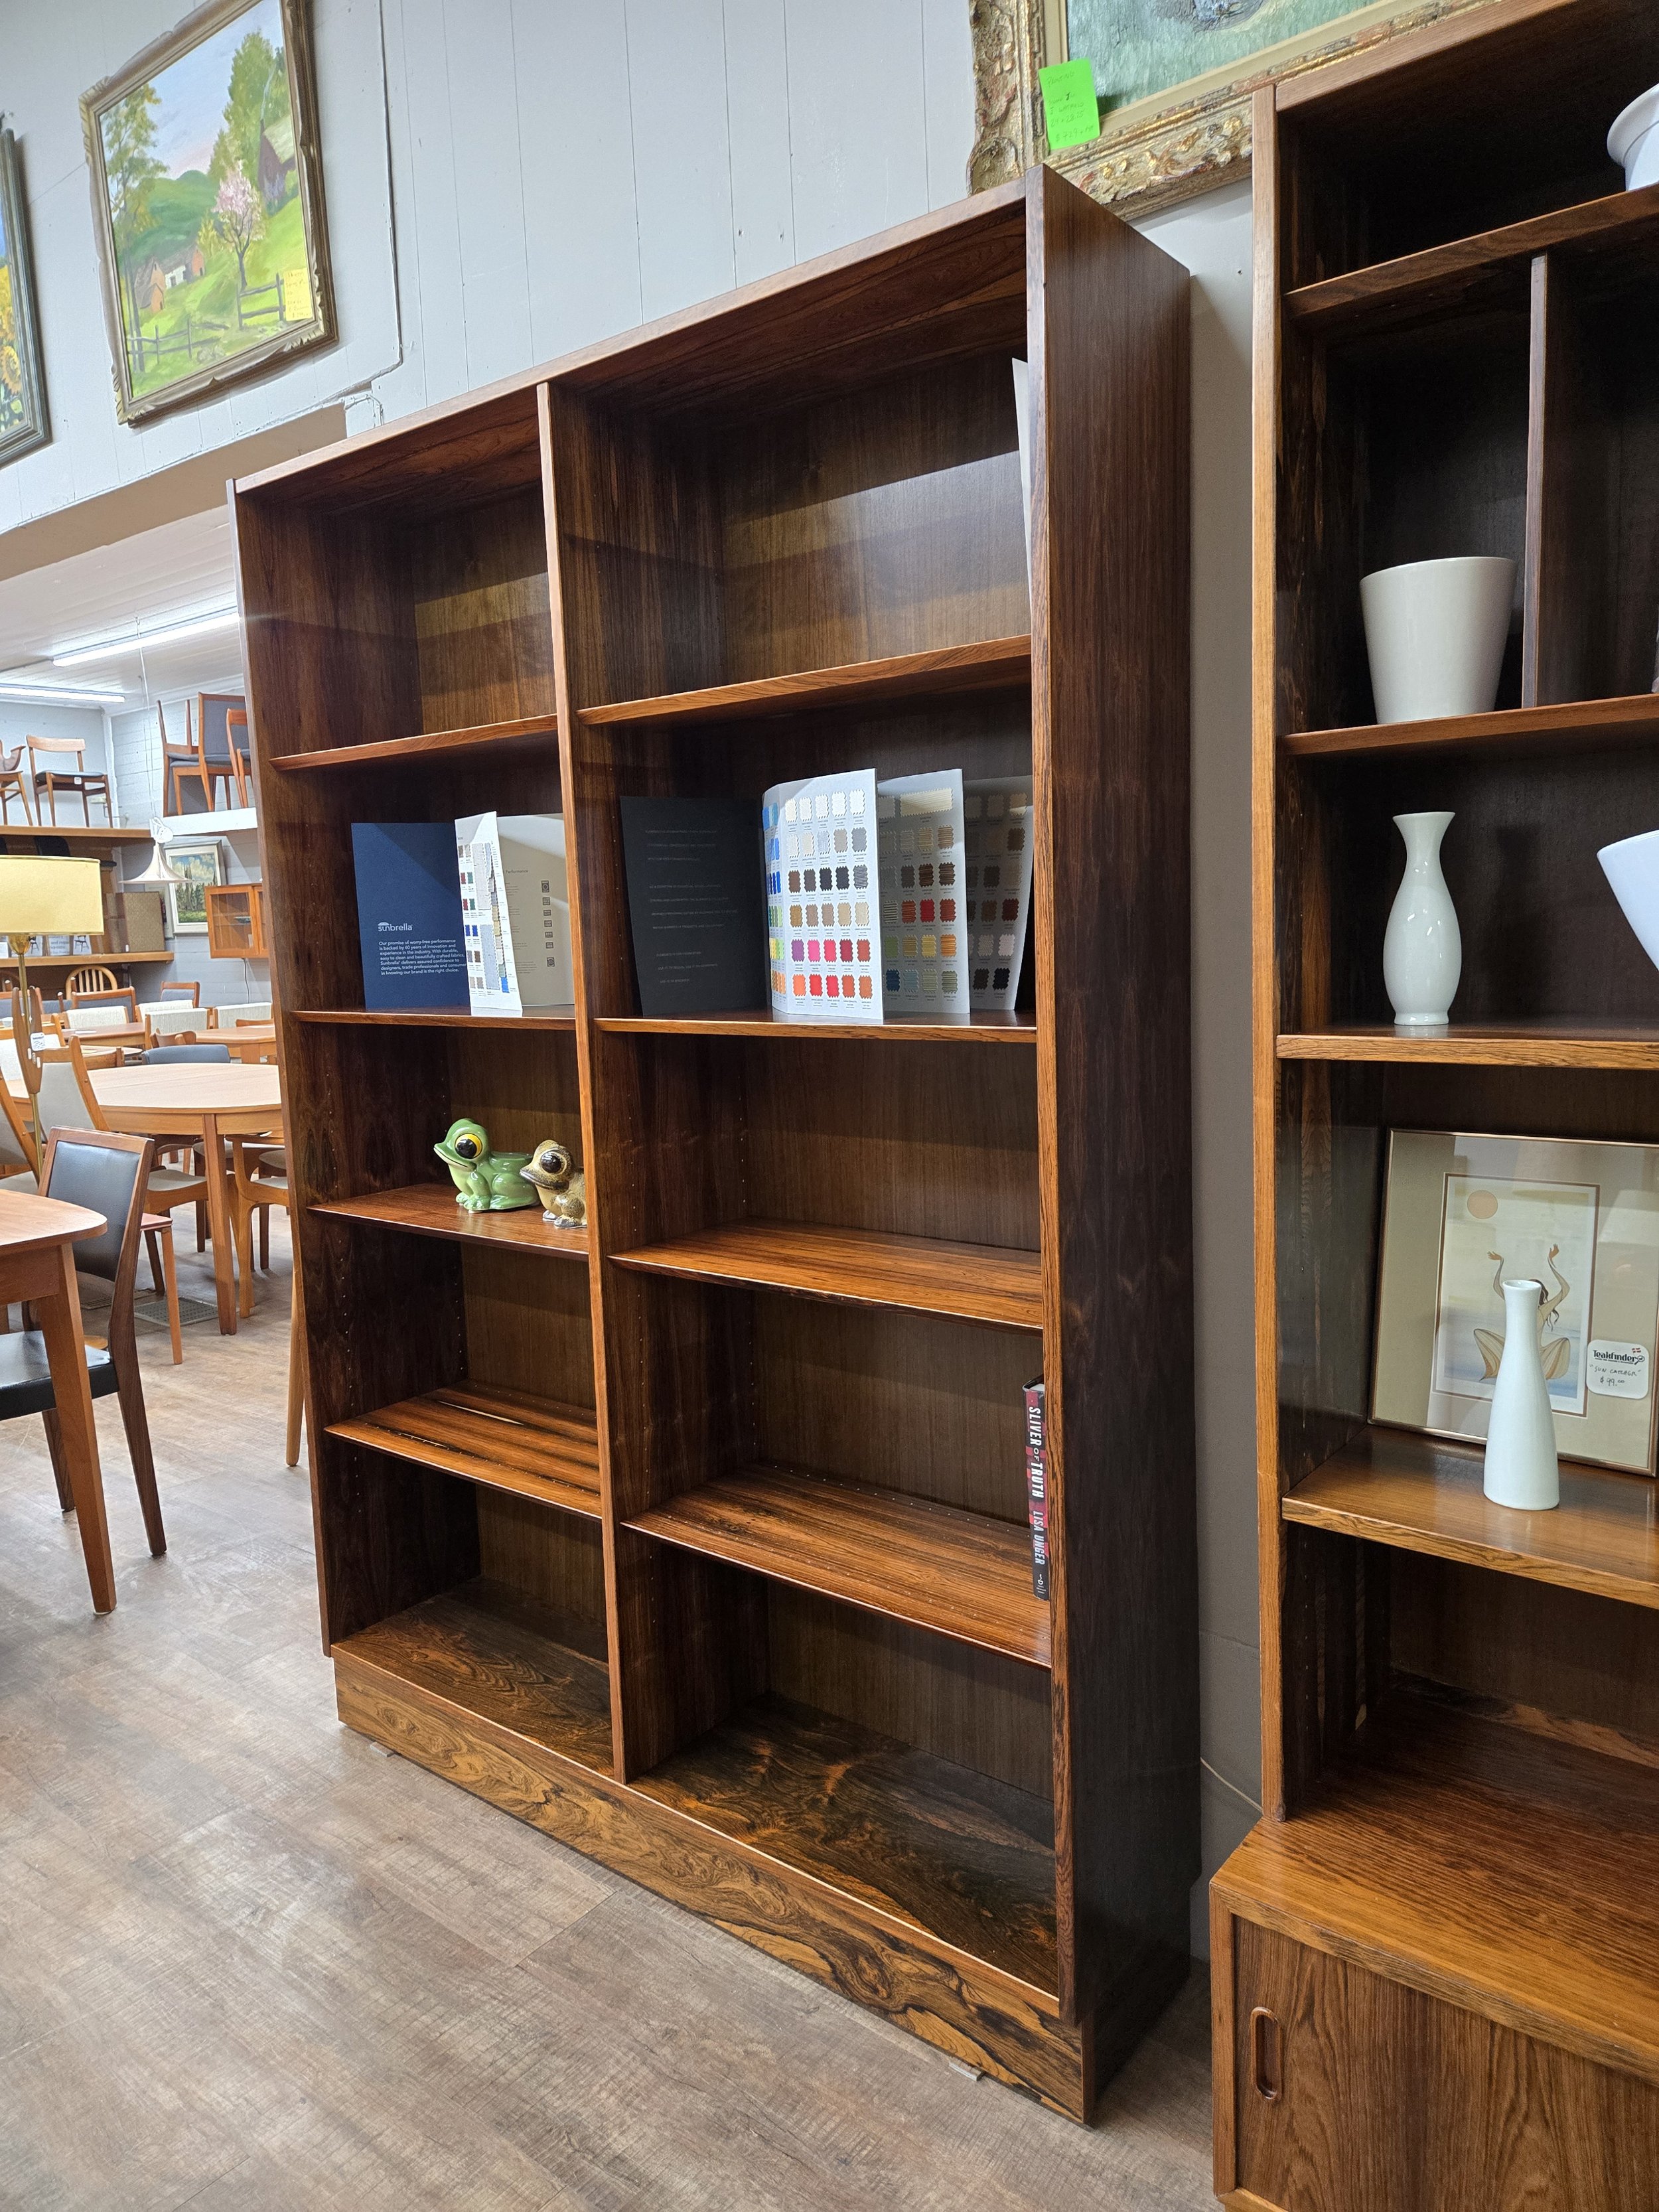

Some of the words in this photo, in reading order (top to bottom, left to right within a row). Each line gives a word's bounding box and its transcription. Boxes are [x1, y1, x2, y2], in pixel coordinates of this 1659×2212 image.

[1593, 1350, 1637, 1362] Teakfinder
[1029, 1406, 1042, 1446] SLIVER
[1033, 1448, 1041, 1461] OF
[1031, 1463, 1045, 1499] TRUTH
[1033, 1511, 1044, 1532] LISA
[1034, 1534, 1045, 1565] UNGER
